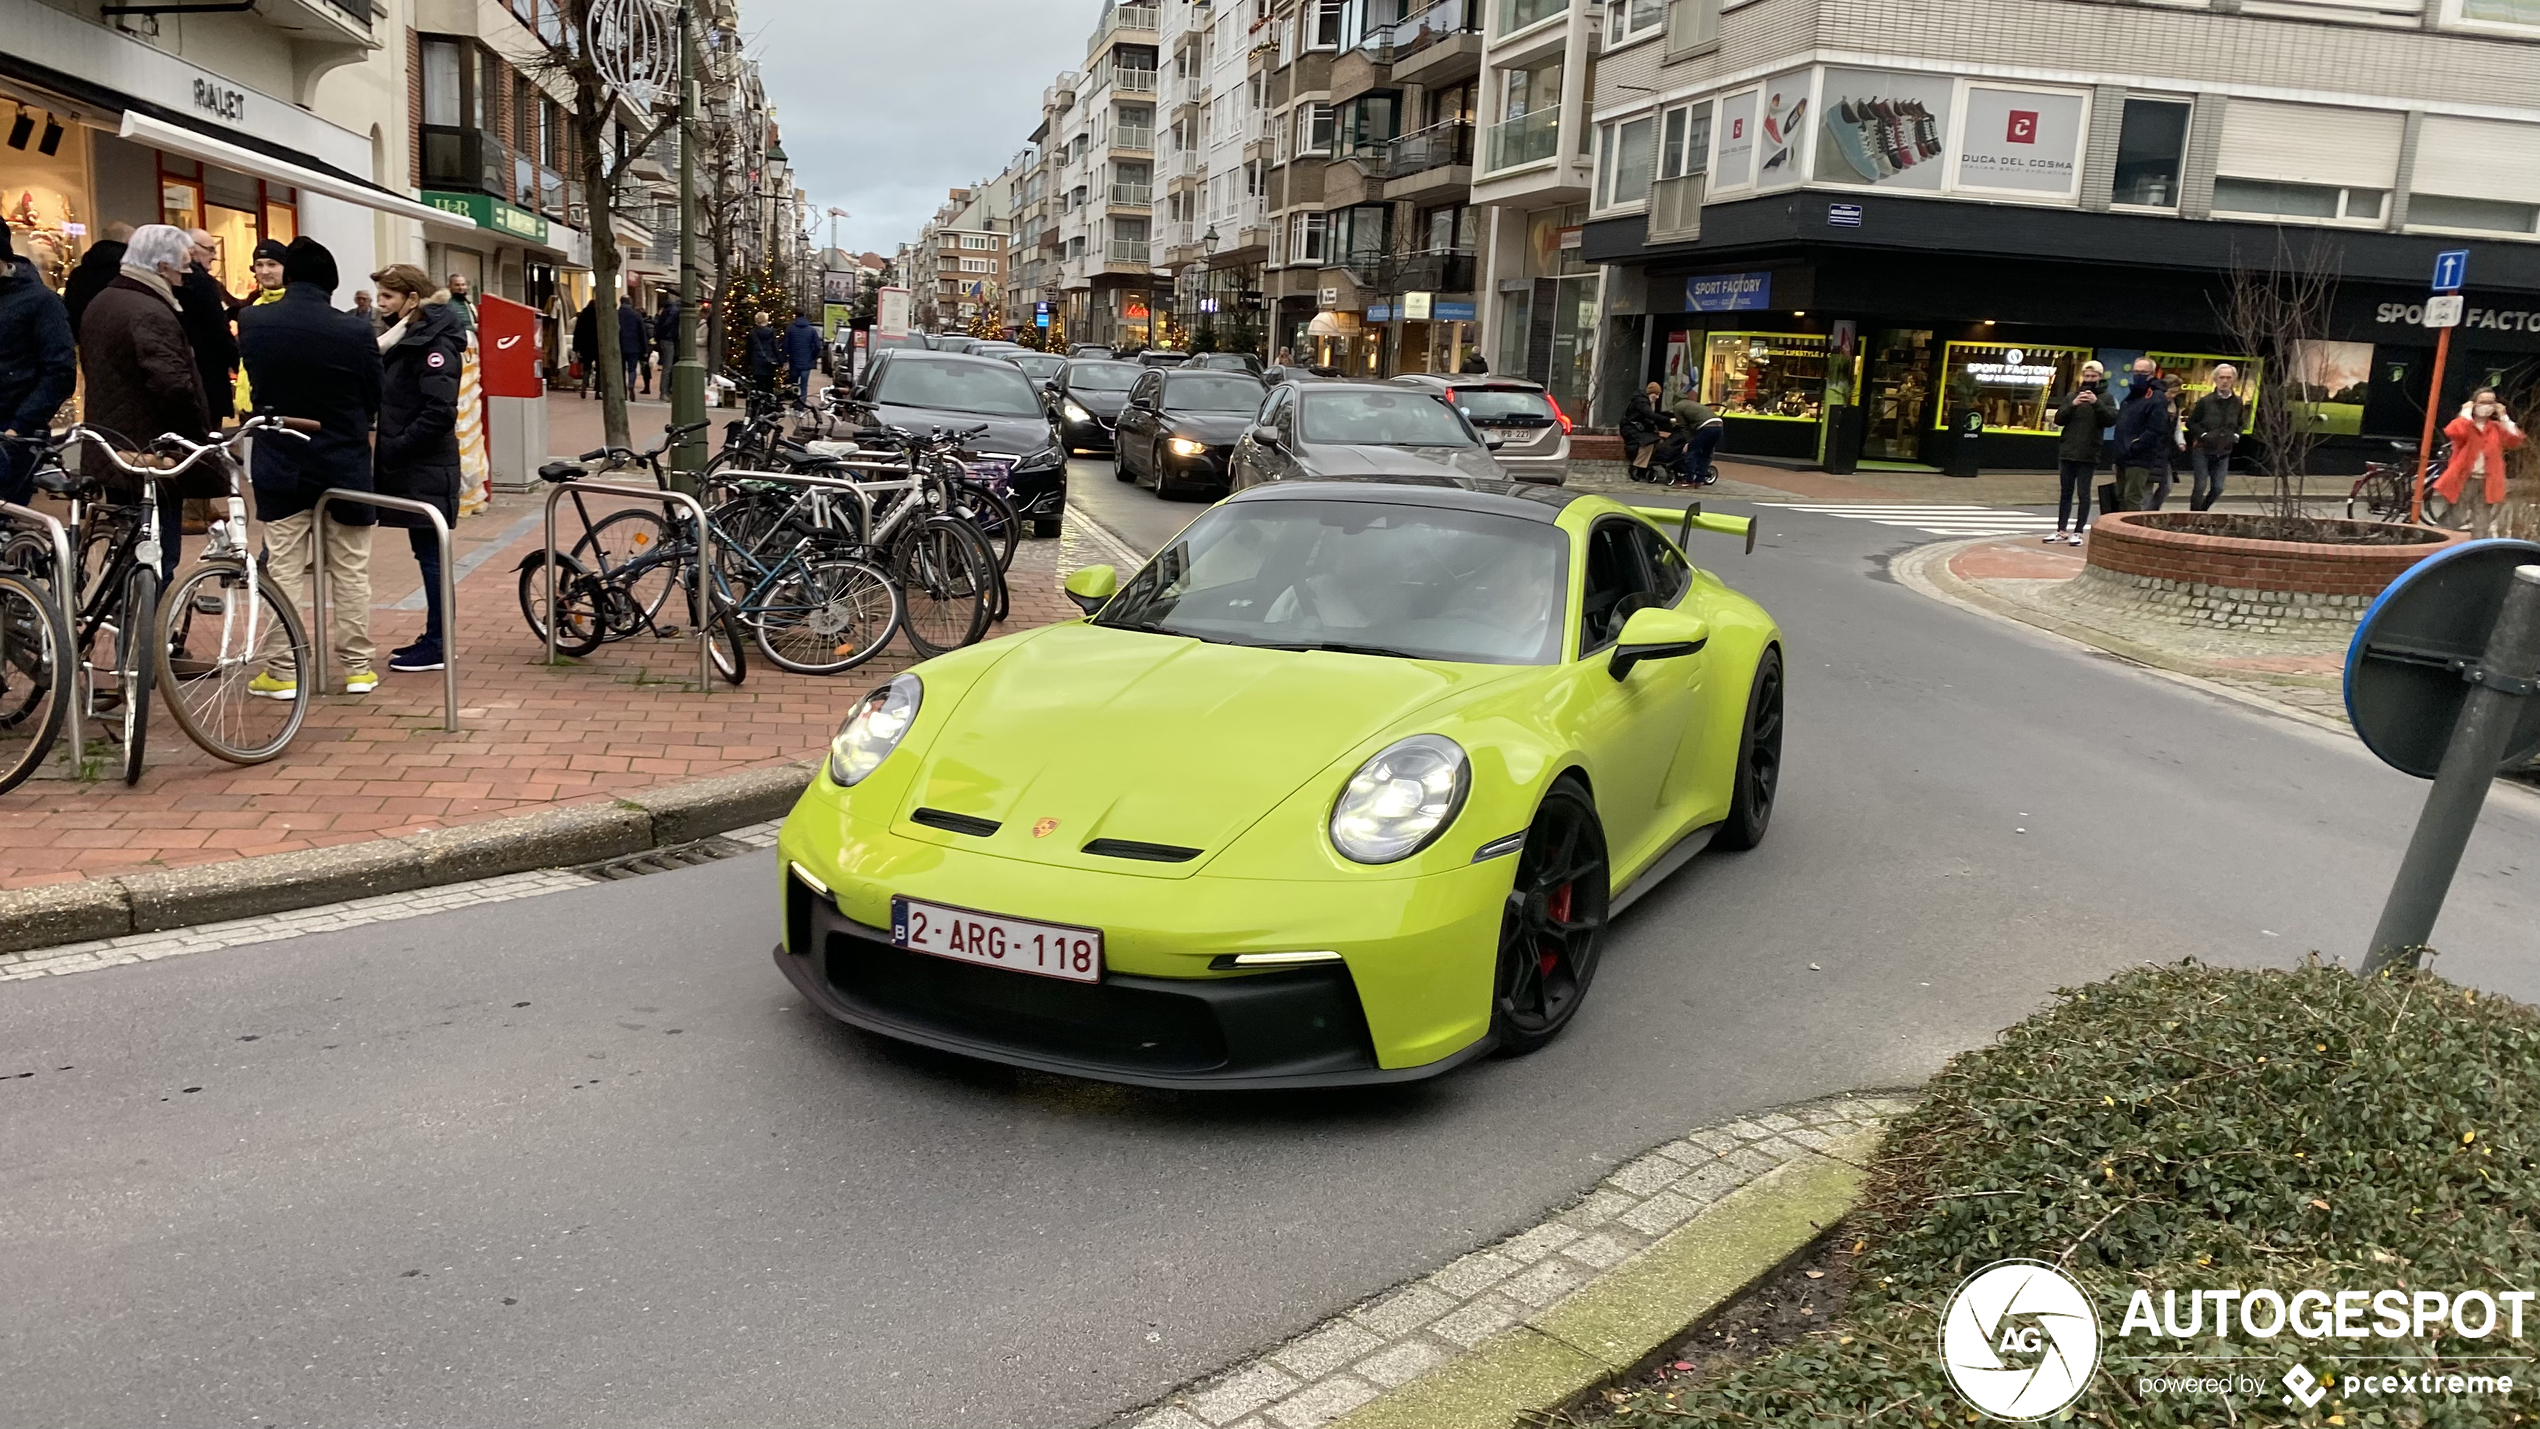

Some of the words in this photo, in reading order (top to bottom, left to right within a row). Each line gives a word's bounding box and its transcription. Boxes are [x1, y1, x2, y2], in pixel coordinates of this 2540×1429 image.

[1961, 154, 1996, 164] DUCA
[2001, 156, 2025, 166] DEL
[2029, 159, 2073, 170] COSMA
[1694, 281, 1721, 295] SPORT
[1722, 278, 1762, 294] FACTORY
[2376, 302, 2427, 325] SPO
[1967, 362, 2005, 374] SPORT
[2005, 364, 2058, 376] FACTORY
[895, 924, 906, 940] B
[911, 911, 1092, 973] 2-ARG-118
